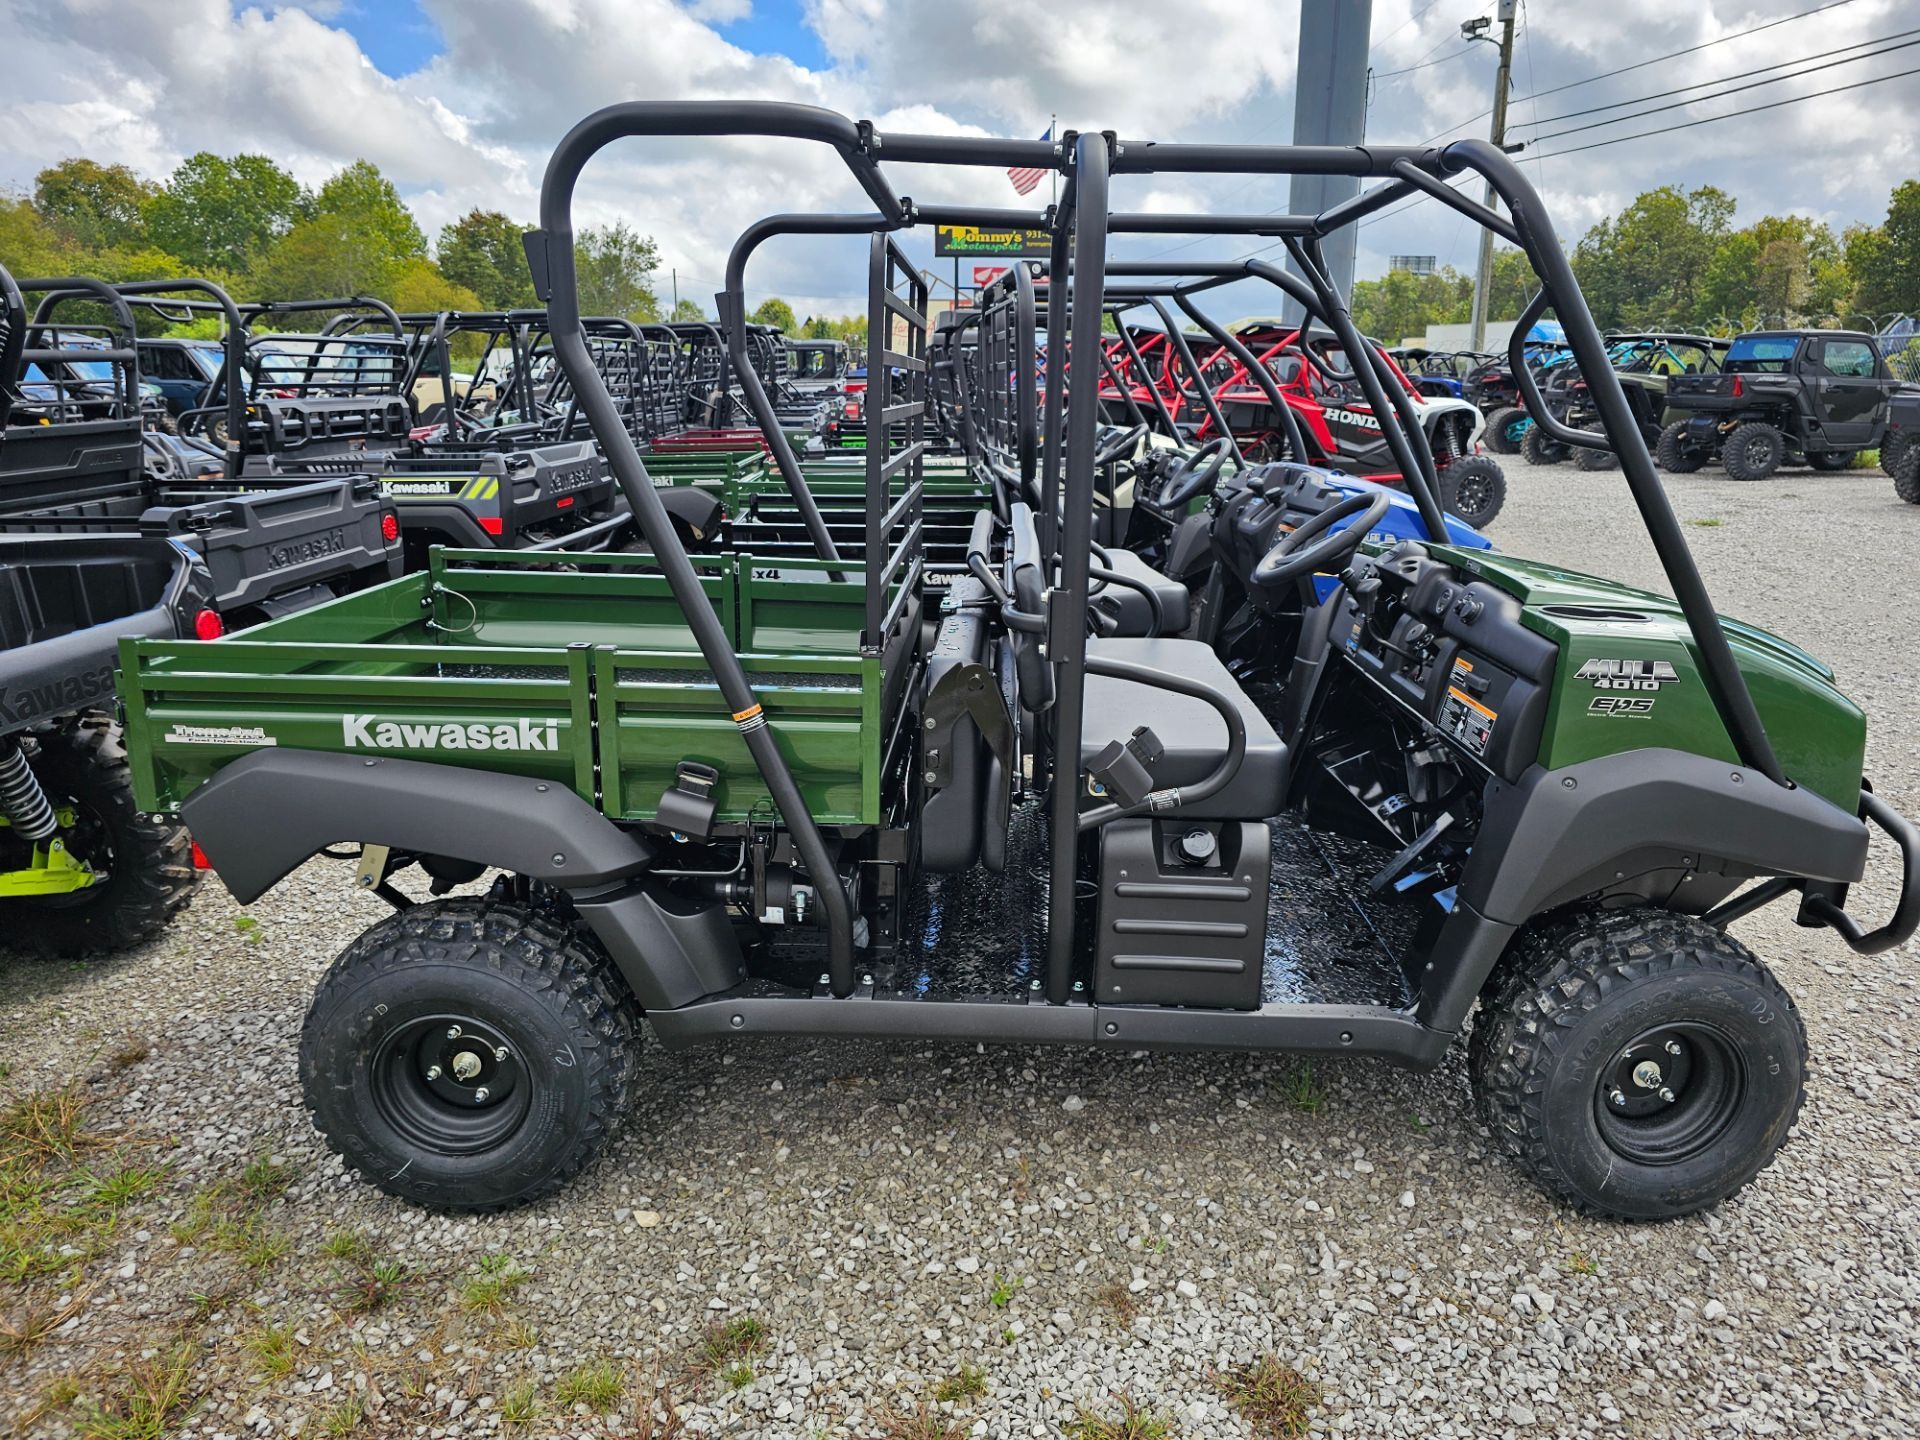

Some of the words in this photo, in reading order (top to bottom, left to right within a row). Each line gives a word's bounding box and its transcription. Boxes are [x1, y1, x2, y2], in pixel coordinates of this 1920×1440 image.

[938, 225, 1023, 246] Tommy's
[944, 237, 1024, 253] Motorsports
[1323, 407, 1382, 430] HOND
[381, 481, 450, 495] Kawasaki
[265, 528, 346, 571] Kawasaki
[752, 569, 782, 580] x4
[1573, 658, 1681, 683] MULE
[0, 653, 119, 725] Kawasa
[1593, 680, 1661, 692] 4010
[1588, 696, 1656, 715] EPS
[343, 713, 559, 751] Kawasaki
